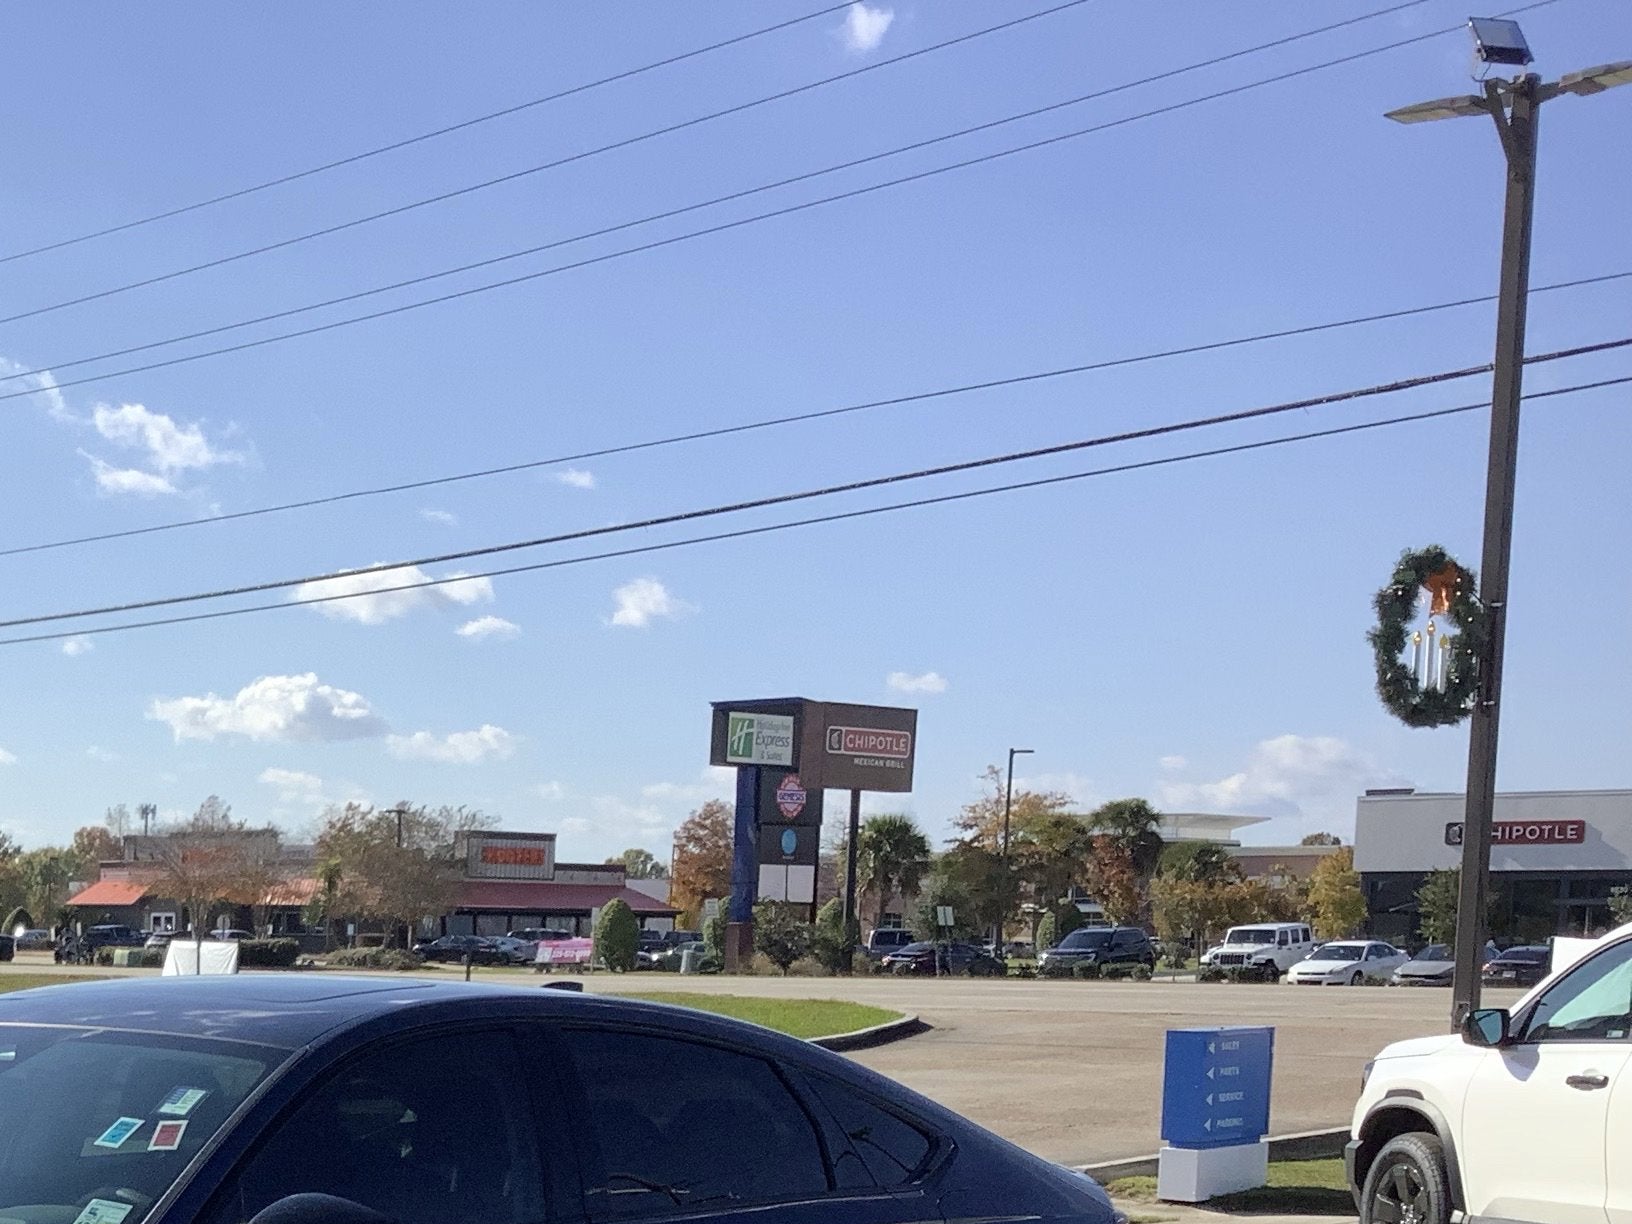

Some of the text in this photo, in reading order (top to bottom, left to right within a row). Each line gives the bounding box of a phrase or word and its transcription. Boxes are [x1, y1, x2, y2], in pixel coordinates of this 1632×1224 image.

[756, 731, 791, 749] Express
[846, 734, 906, 752] CHIPOTLE
[853, 757, 884, 768] MEXICAN
[1490, 825, 1578, 840] HIPOTLE
